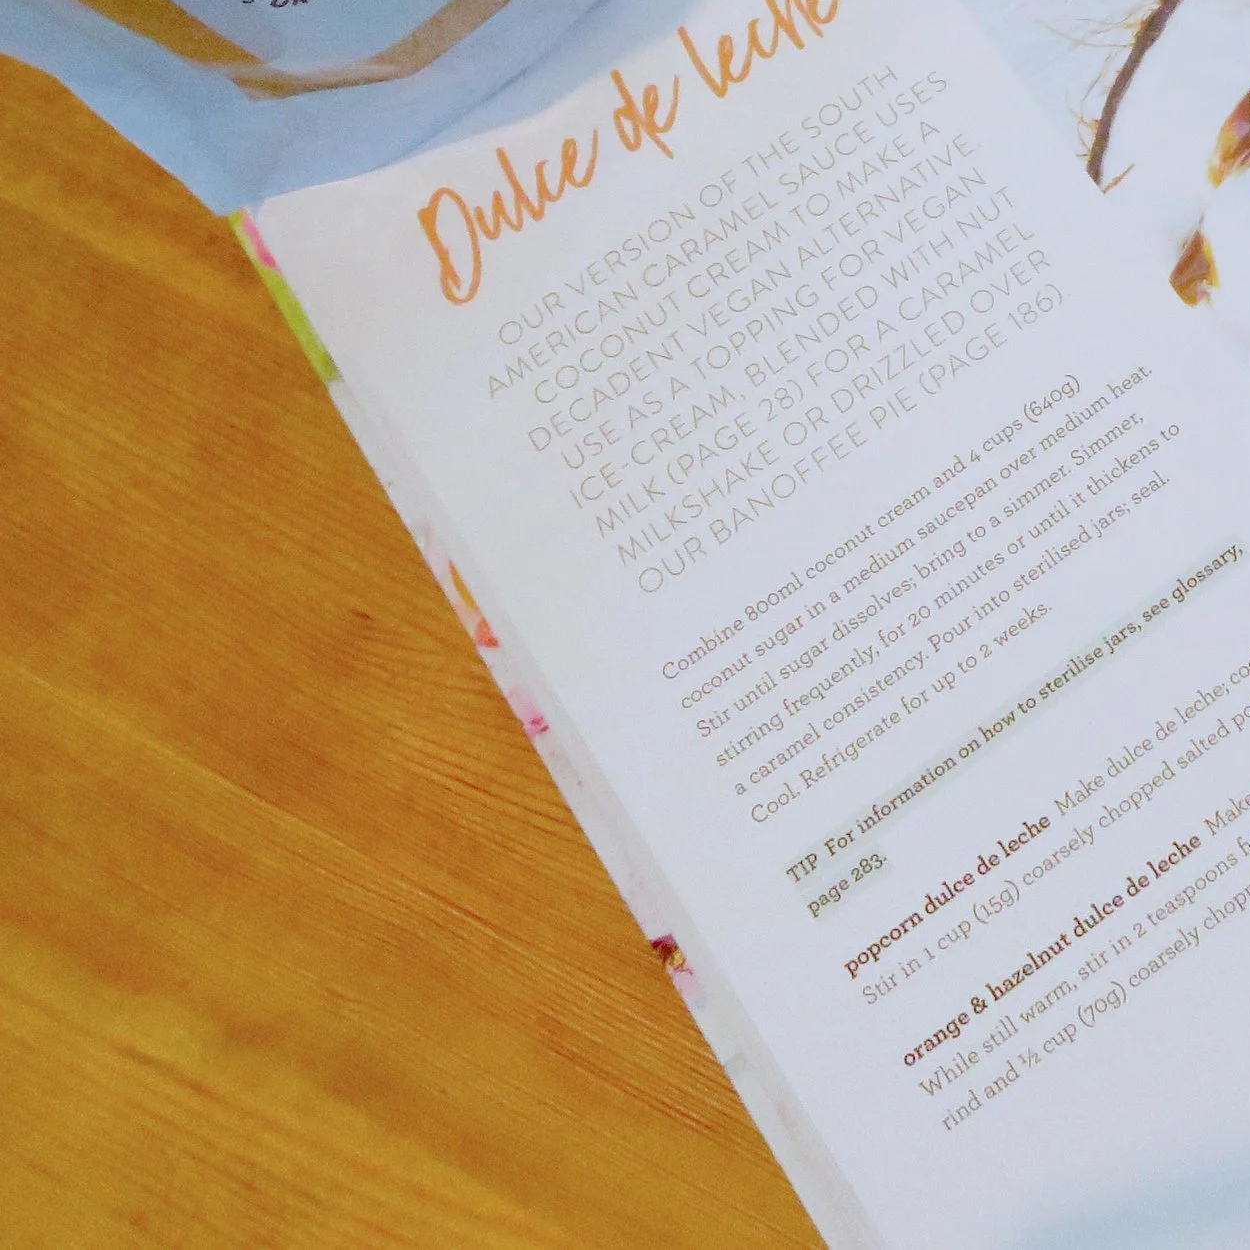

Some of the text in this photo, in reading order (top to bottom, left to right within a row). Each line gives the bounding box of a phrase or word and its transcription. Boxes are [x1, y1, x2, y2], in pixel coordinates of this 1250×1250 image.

[418, 127, 599, 306] Dulce
[612, 68, 680, 160] de
[488, 70, 948, 400] AMERICAN CARAMEL SAUCE USES
[497, 64, 899, 346] OUR VERSION OF THE SOUTH
[534, 120, 941, 405] COCONUT CREAM TO MAKE A
[560, 166, 987, 470] USE AS A TOPPING FOR VEGAN
[527, 330, 685, 453] DECADENT
[685, 259, 793, 338] VEGAN
[569, 185, 1014, 510] ICE-CREAM, BLENDED WITH NUT
[595, 222, 1035, 539] MILK (PAGE 28) FOR A CARAMEL
[616, 249, 1052, 568] MILKSHAKE OR DRIZZLED OVER
[638, 536, 709, 594] OUR
[708, 421, 870, 546] BANOFFEE
[868, 386, 918, 431] PIE
[918, 322, 1008, 396] (PAGE
[661, 374, 1081, 680] Combine 800ml coconut cream and 4 cups (640g)
[681, 366, 1153, 710] coconut sugar in a medium saucepan over medium heat.
[696, 412, 1144, 738] Stir until sugar dissolves; bring to a simmer. Simmer,
[734, 469, 1171, 796] a caramel consistency. Pour into sterilised jars; seal.
[785, 544, 1244, 883] TIP For information on how to sterilise jars, see glossary,
[843, 911, 925, 980] popcorn
[924, 872, 976, 915] dulce
[976, 853, 1001, 876] de
[996, 815, 1051, 859] leche
[1053, 775, 1105, 816] Make
[1107, 738, 1153, 778] dulce
[1155, 720, 1176, 741] de
[1174, 683, 1230, 724] leche;
[806, 853, 888, 919] page 283.
[903, 1011, 971, 1067] orange
[969, 996, 989, 1015] &
[984, 933, 1072, 1002] hazelnut
[1072, 894, 1125, 938] dulce
[1125, 874, 1151, 898] de
[1145, 835, 1202, 880] leche
[917, 1050, 981, 1097] While
[982, 1014, 1020, 1054] still
[1019, 980, 1078, 1024] warm,
[1077, 950, 1110, 981] stir
[1108, 935, 1133, 956] in
[1132, 922, 1148, 939] 2
[1146, 852, 1239, 927] teaspoons
[941, 1088, 983, 1132] rind
[983, 1059, 1021, 1100] and
[1042, 1023, 1078, 1054] cup
[1077, 980, 1127, 1028] (70g)
[1128, 925, 1200, 988] coarsely
